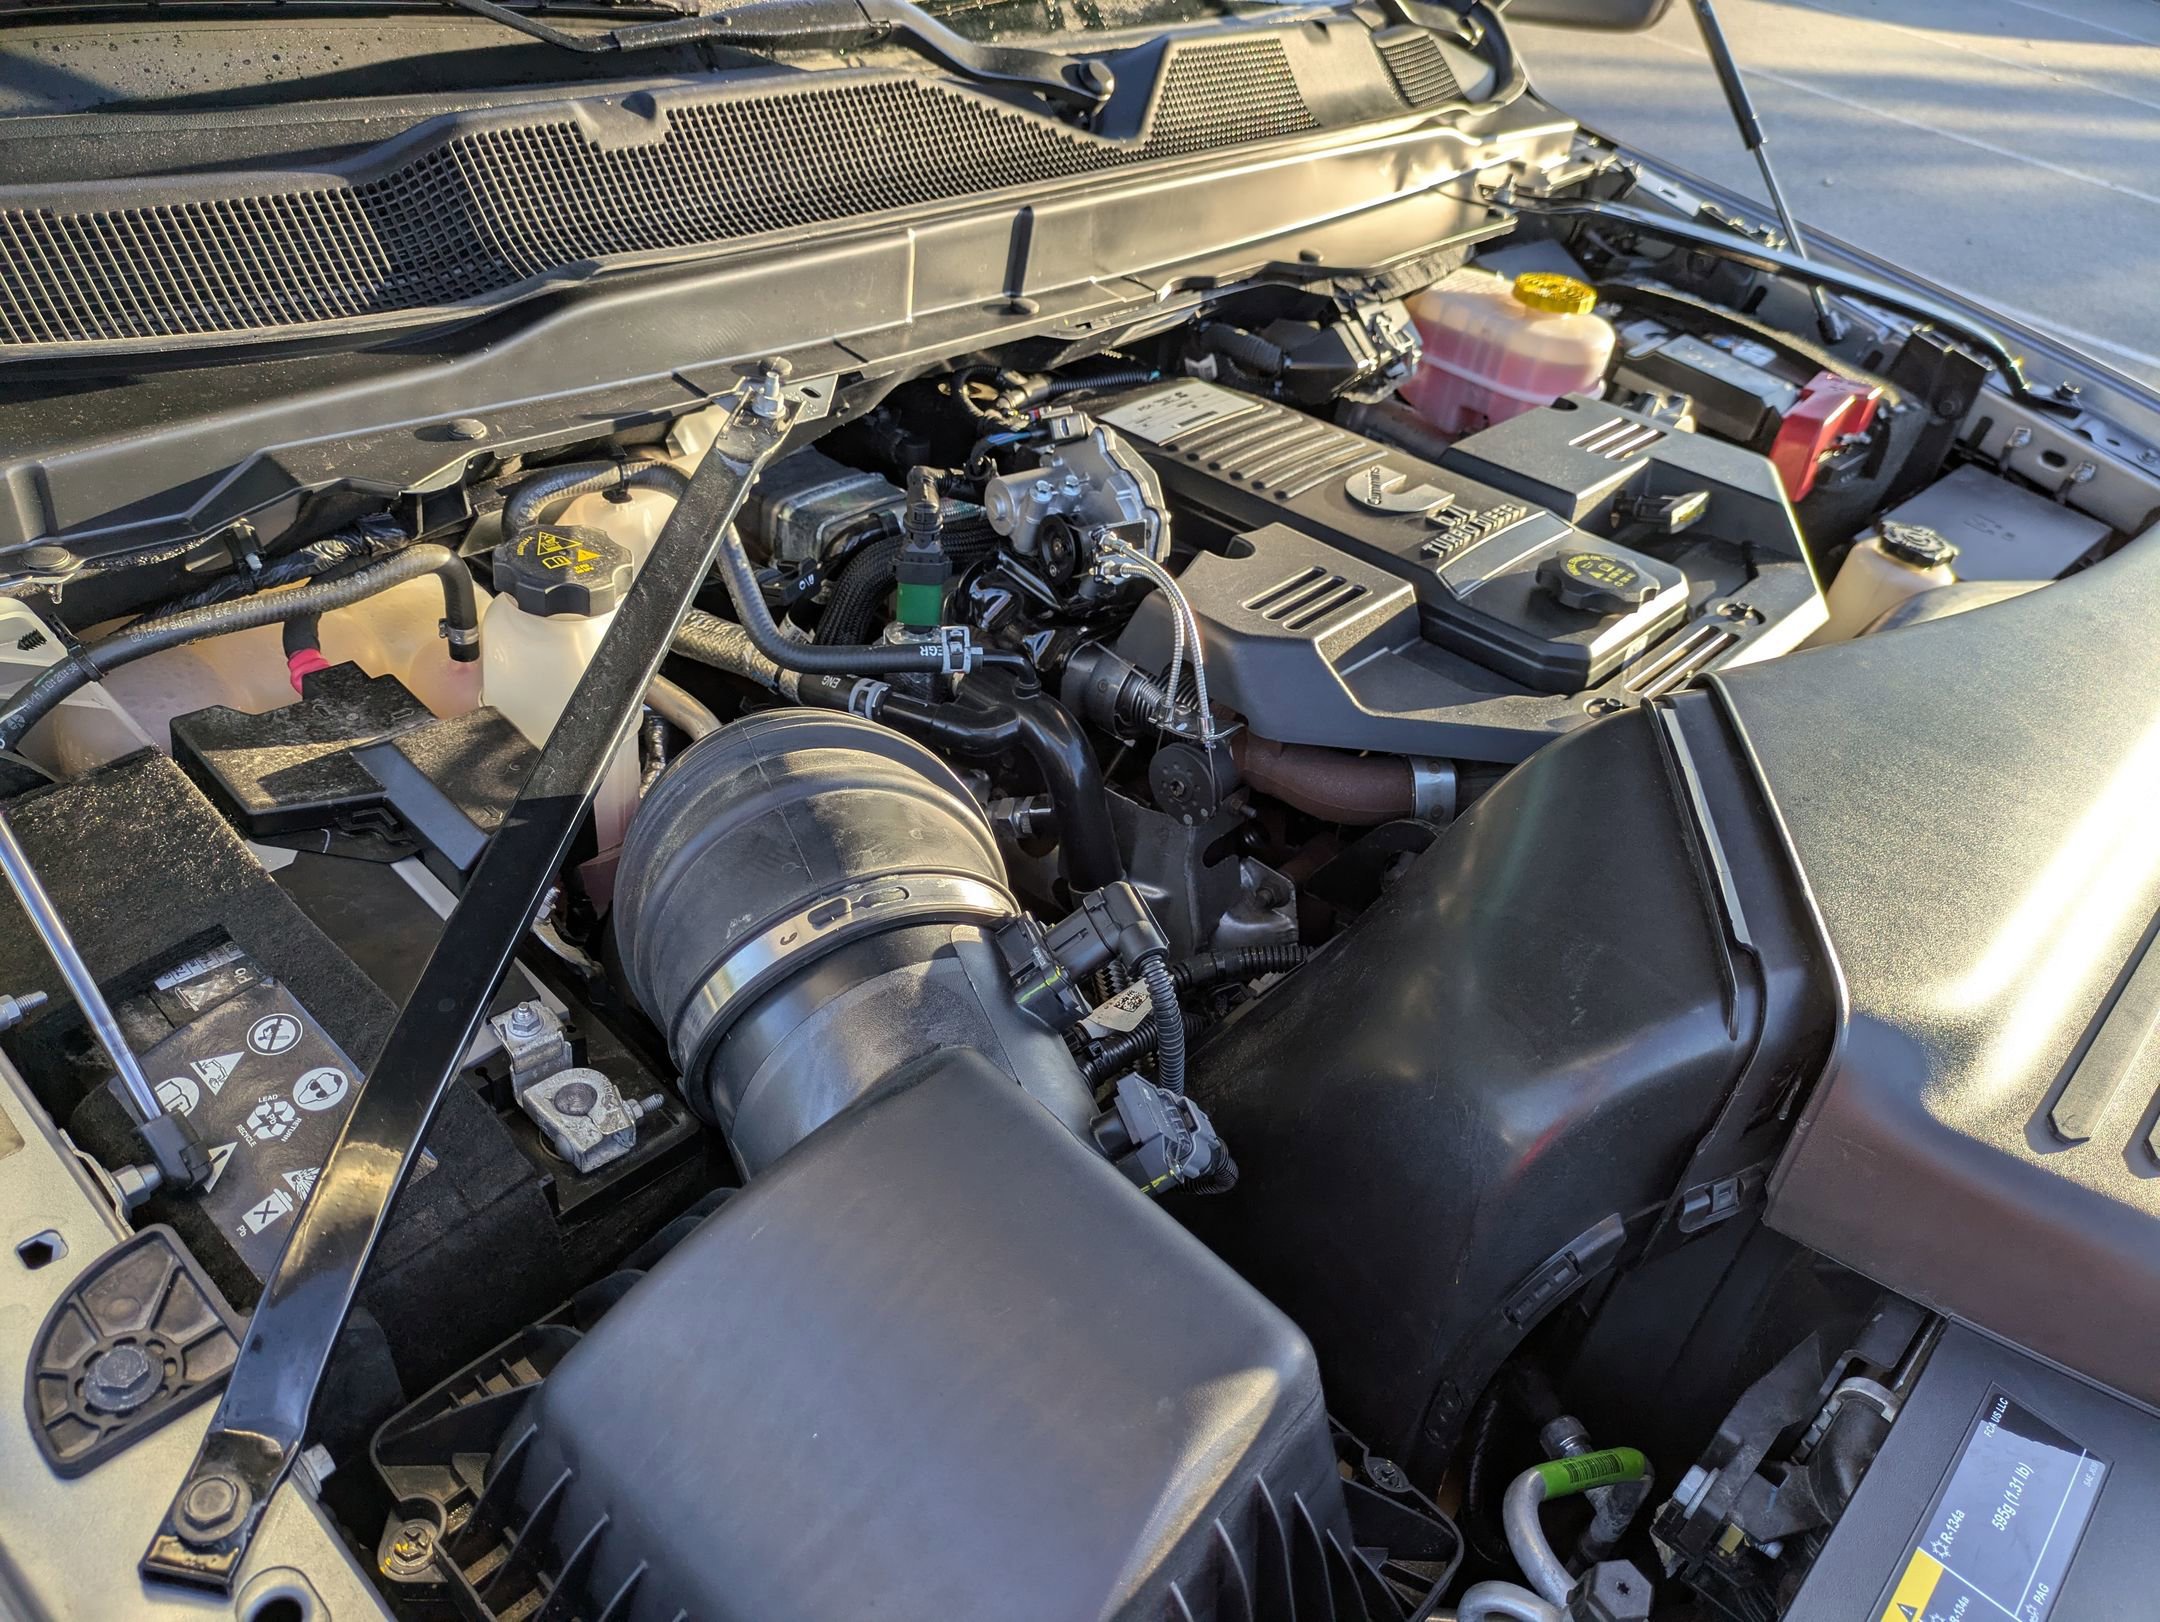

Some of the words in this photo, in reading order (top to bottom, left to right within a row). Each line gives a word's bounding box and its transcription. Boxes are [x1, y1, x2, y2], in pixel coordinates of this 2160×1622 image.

[1421, 524, 1481, 558] TURBO
[919, 645, 943, 657] EGR
[820, 674, 841, 689] ENG
[258, 1093, 278, 1103] LEAD
[266, 1113, 277, 1125] Pb
[236, 1124, 257, 1148] RECYCLE
[280, 1117, 302, 1143] RETURN
[236, 1225, 248, 1238] Pb
[1995, 1397, 2009, 1413] LLC
[1990, 1410, 2002, 1424] US
[1984, 1422, 1998, 1438] FCA
[2014, 1462, 2035, 1480] lb)
[2003, 1476, 2025, 1506] (1.31
[1991, 1503, 2017, 1531] 595g
[1940, 1509, 1966, 1545] R-134a
[2033, 1582, 2050, 1606] PAG
